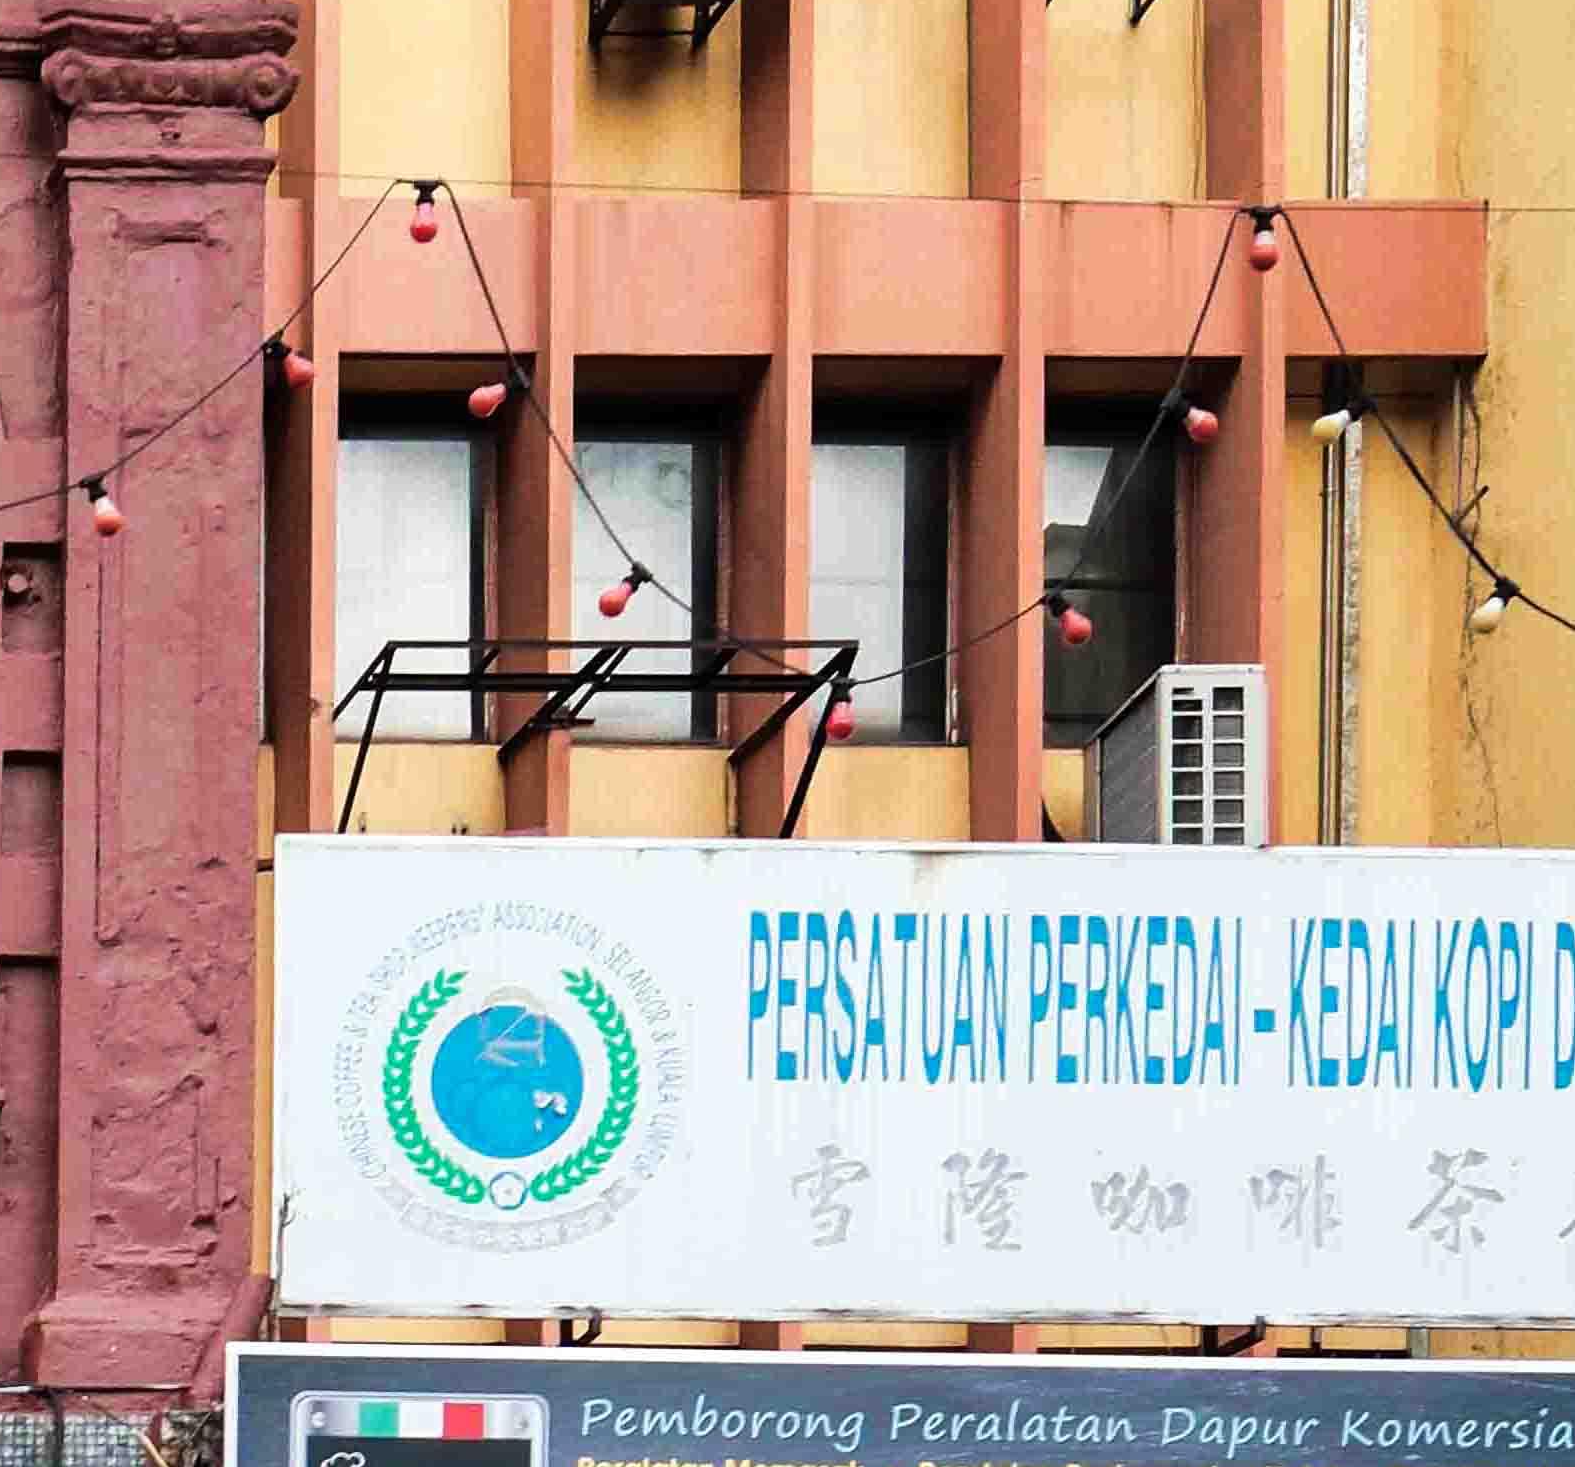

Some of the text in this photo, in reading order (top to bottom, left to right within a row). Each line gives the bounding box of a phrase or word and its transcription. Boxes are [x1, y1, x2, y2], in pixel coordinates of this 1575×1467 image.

[747, 909, 1010, 1085] PERSATUAN
[1027, 913, 1243, 1087] PERKEDAI
[1287, 917, 1417, 1089] KEDAI
[1433, 916, 1535, 1092] KOPI
[579, 1396, 866, 1453] Pemborong
[889, 1399, 1137, 1445] Peralatan
[1161, 1405, 1320, 1460] Dapur
